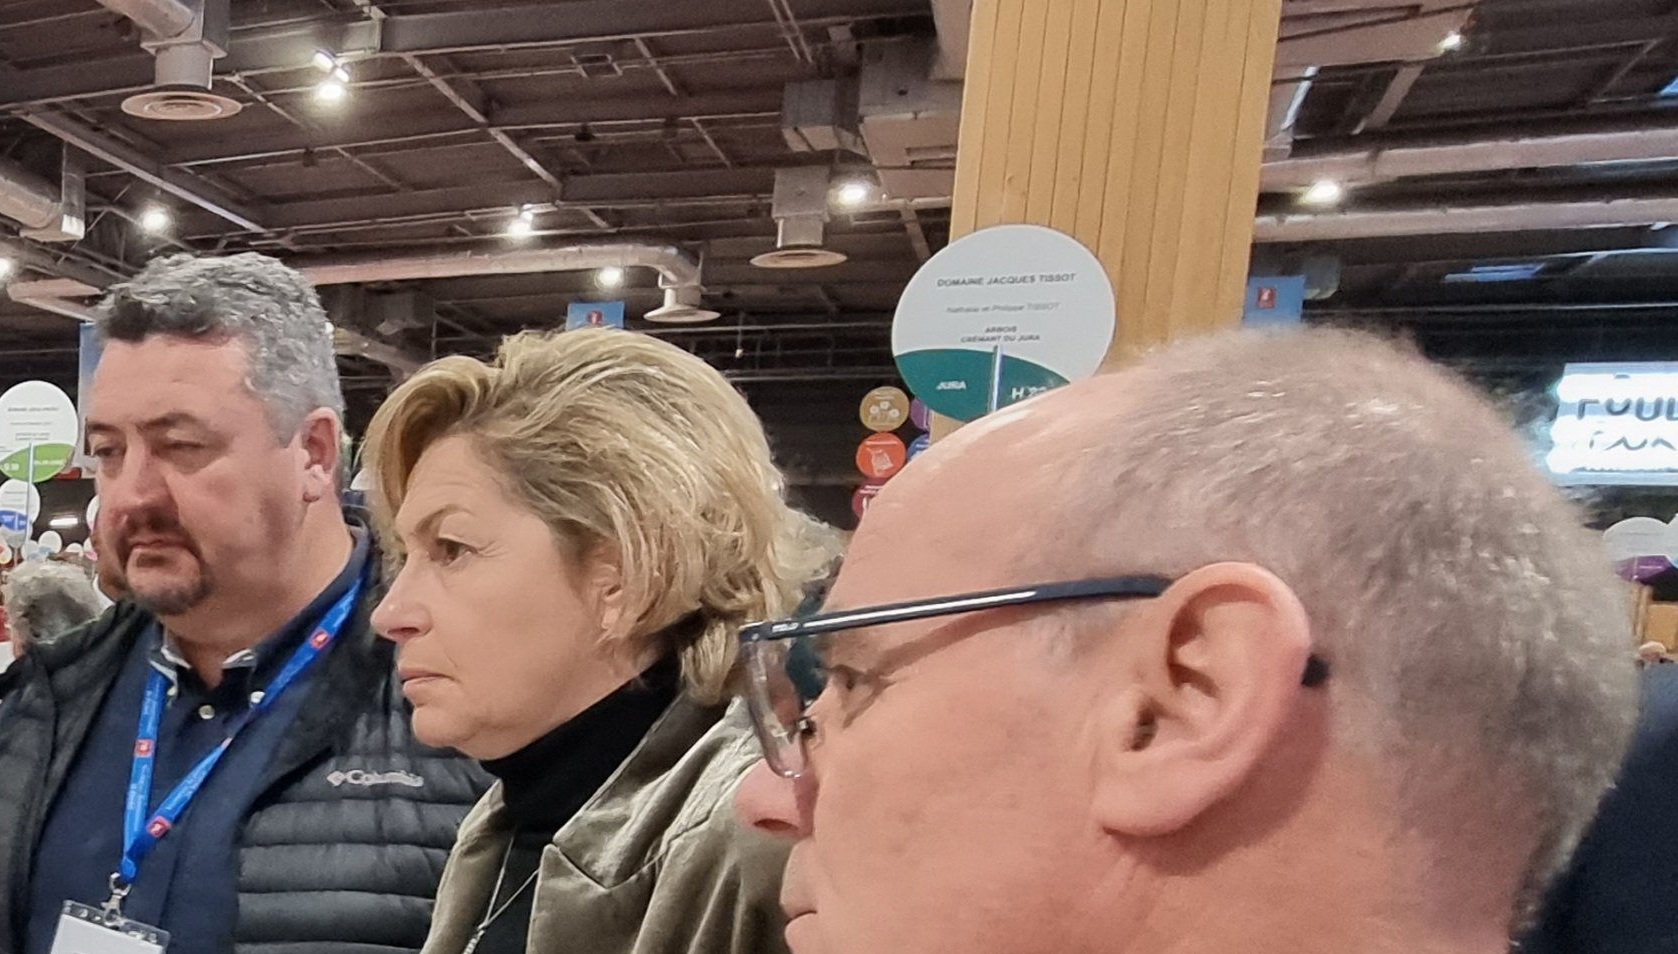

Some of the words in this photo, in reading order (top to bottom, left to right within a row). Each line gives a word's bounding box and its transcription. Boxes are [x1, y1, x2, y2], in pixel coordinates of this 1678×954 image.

[937, 277, 984, 288] DOMAINE
[987, 274, 1035, 286] JACQUES
[1039, 273, 1076, 283] TISSOT
[936, 380, 967, 391] JURA
[1011, 386, 1023, 400] H
